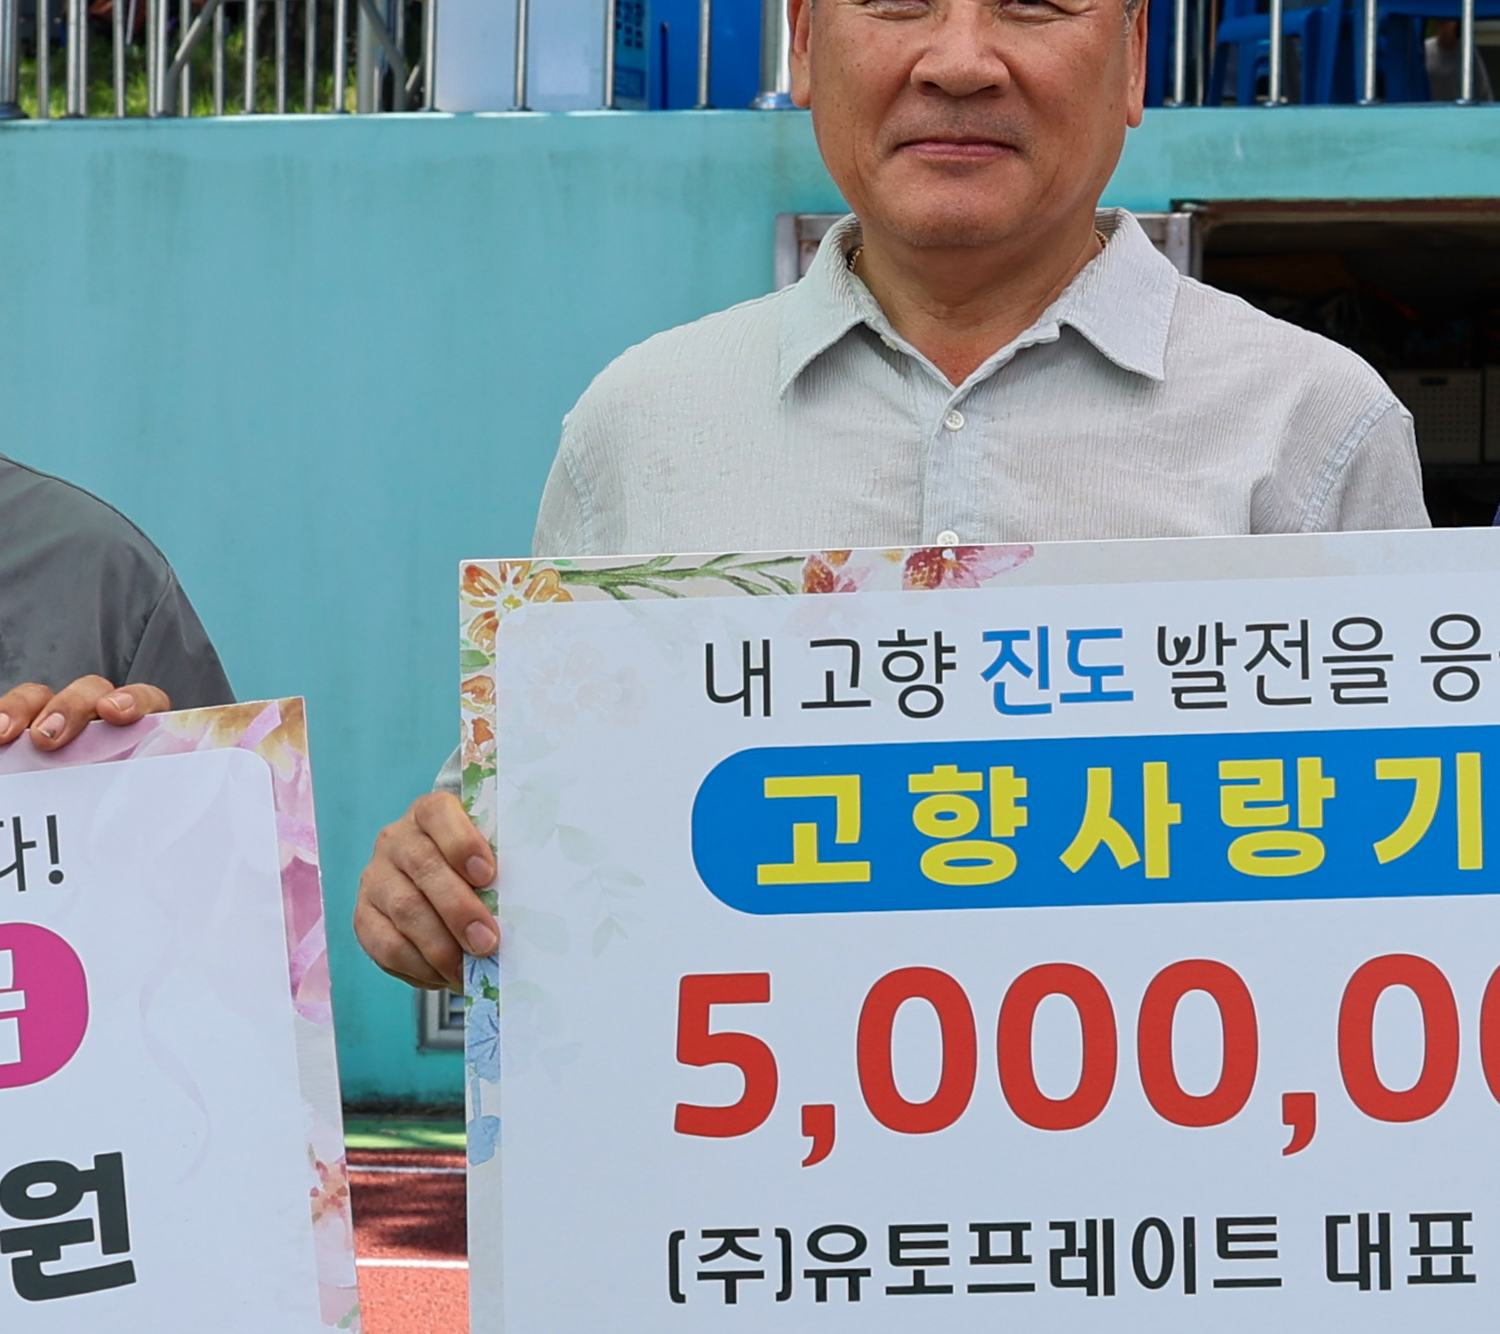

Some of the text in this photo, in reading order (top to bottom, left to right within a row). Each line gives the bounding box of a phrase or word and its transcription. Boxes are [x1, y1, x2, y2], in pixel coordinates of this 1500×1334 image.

[706, 639, 771, 717] 내
[801, 629, 956, 718] 고향
[981, 626, 1134, 715] 진도
[1158, 617, 1393, 709] 발전을
[1326, 1212, 1476, 1291] 대표
